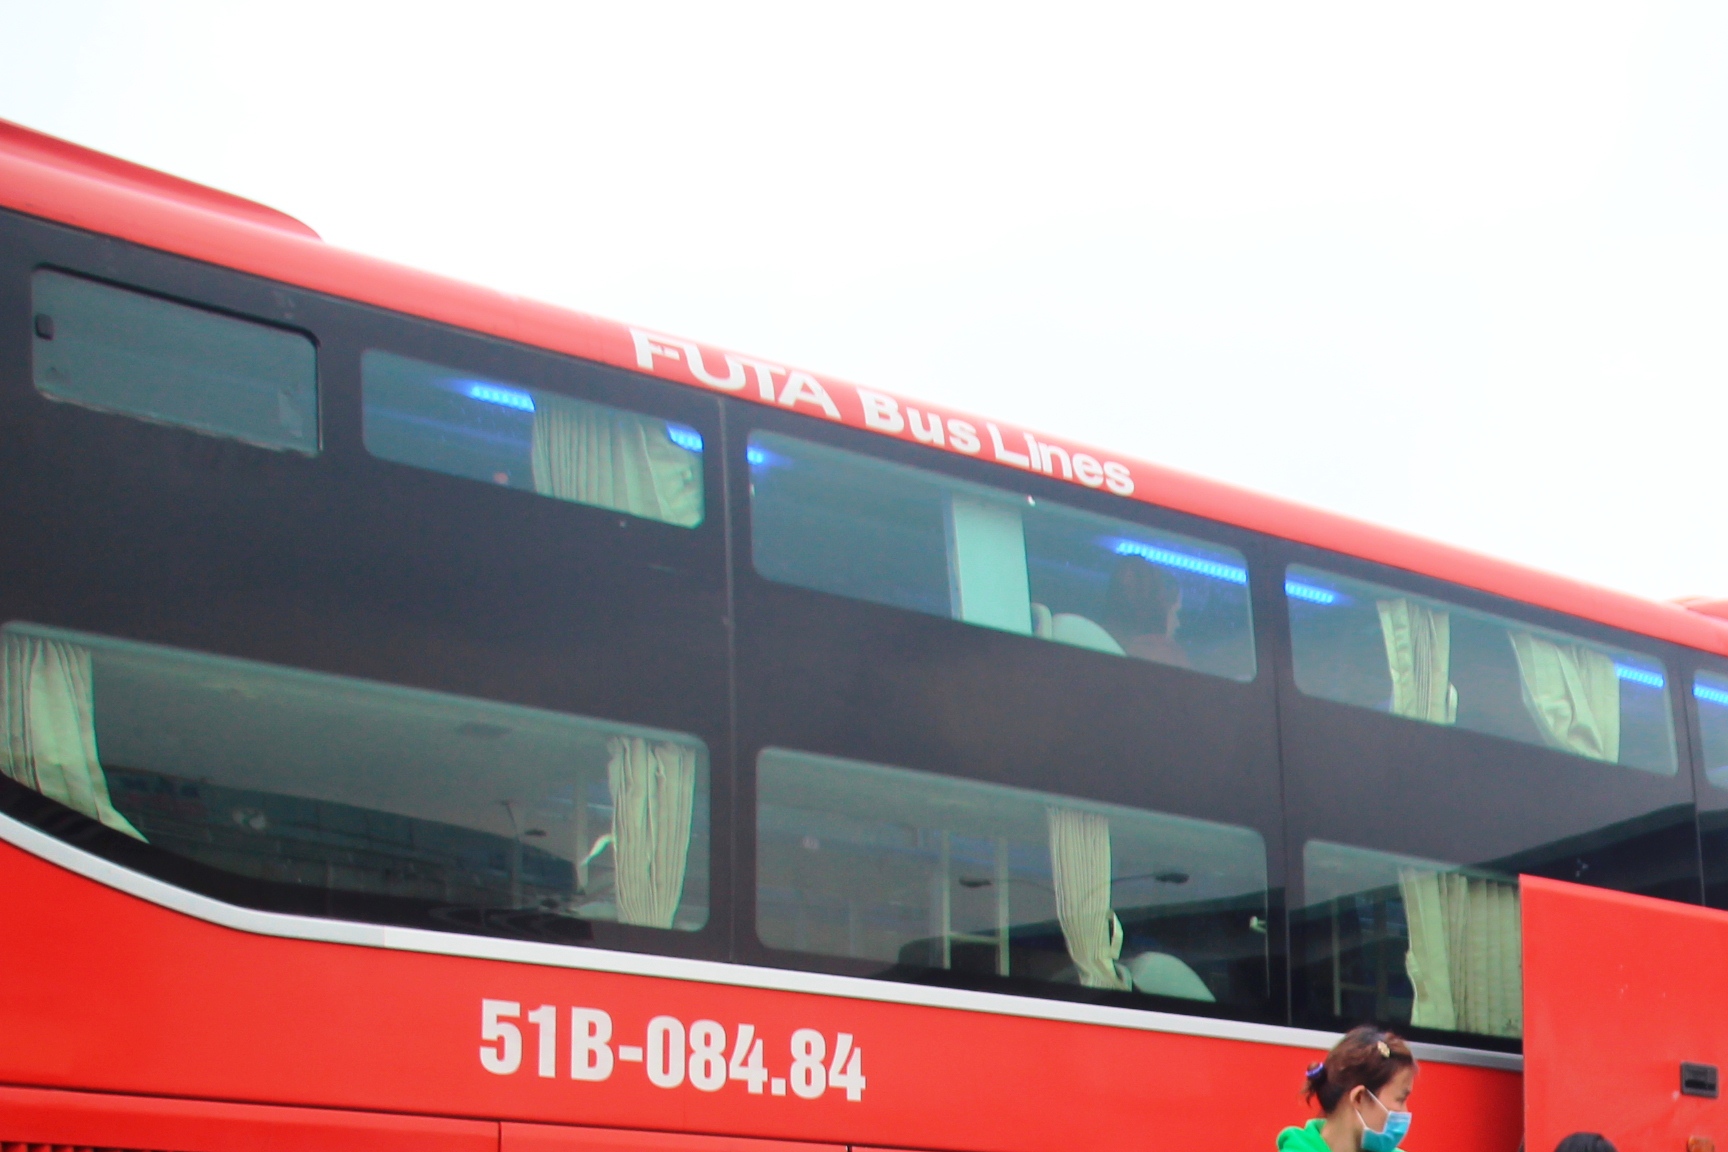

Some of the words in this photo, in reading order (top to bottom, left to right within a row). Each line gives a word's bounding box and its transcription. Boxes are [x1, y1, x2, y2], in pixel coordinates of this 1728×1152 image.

[629, 327, 842, 420] FUTA
[856, 387, 982, 454] Bus
[987, 422, 1135, 497] Lines
[479, 998, 867, 1102] 51B-084.84
